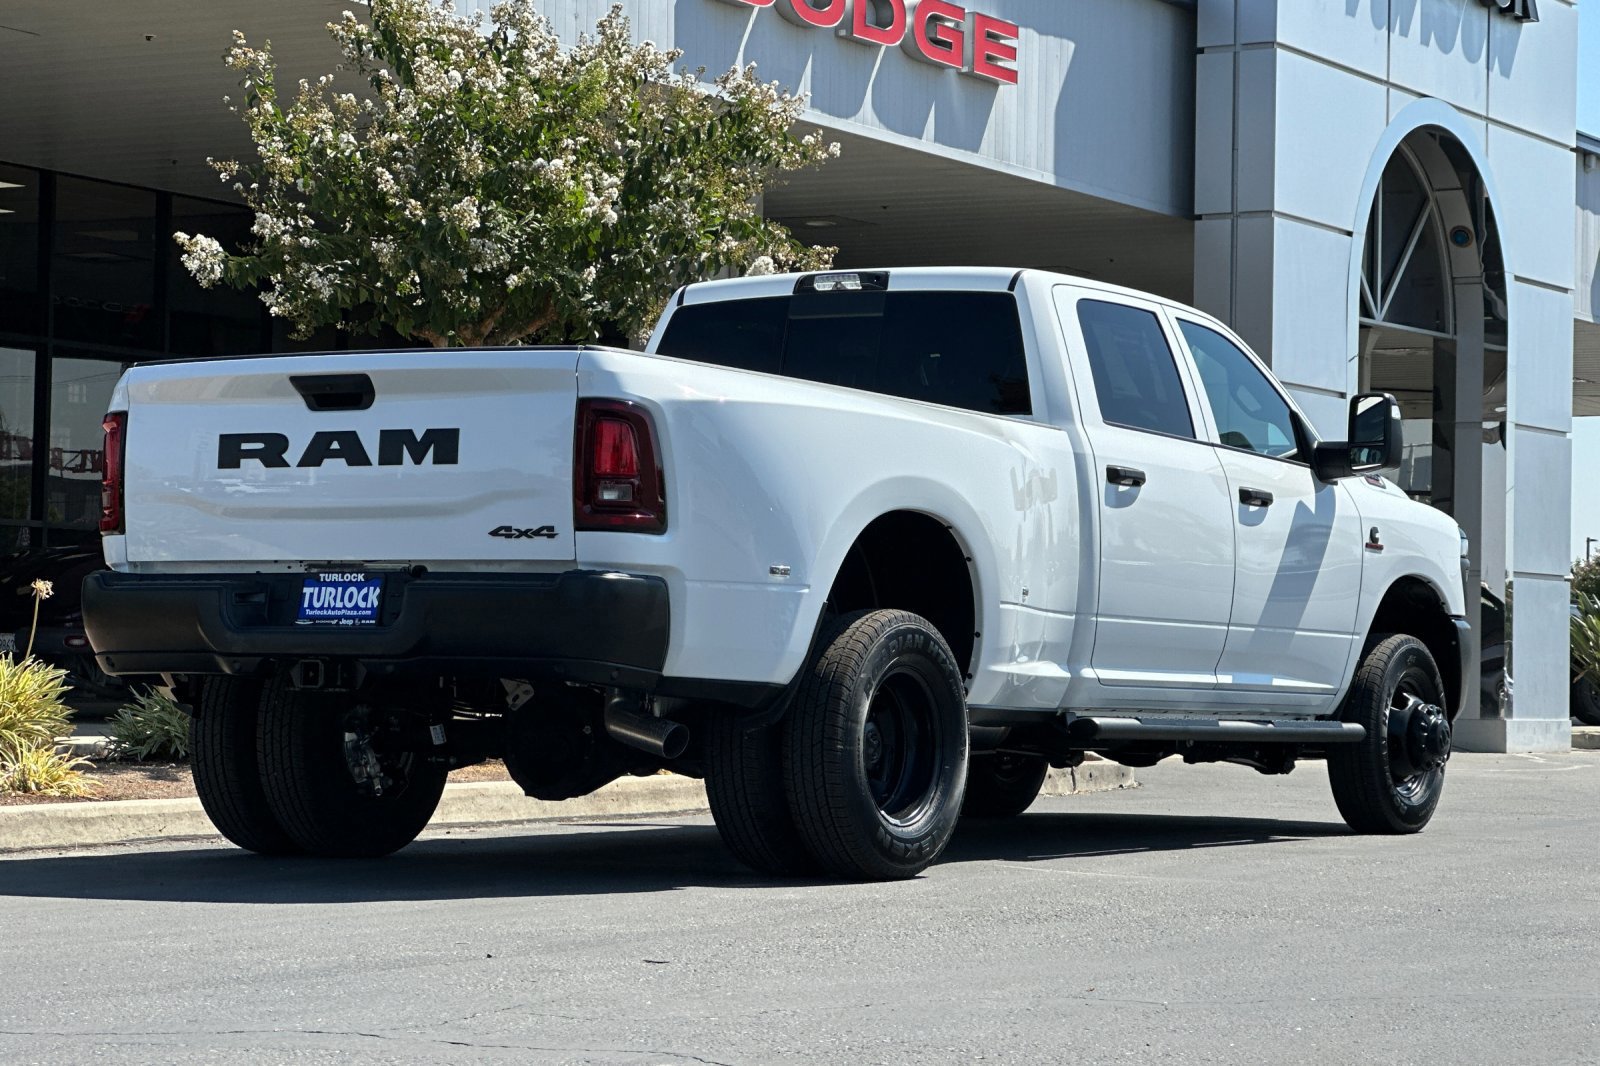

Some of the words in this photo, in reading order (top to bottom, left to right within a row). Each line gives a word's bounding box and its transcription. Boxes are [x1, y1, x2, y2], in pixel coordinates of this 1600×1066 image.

[732, 0, 1019, 84] DGE
[217, 427, 460, 470] RAM
[488, 525, 560, 539] 4x4
[319, 573, 365, 582] TURLOCK
[302, 586, 381, 608] TURLOCK
[339, 618, 354, 626] Jeep
